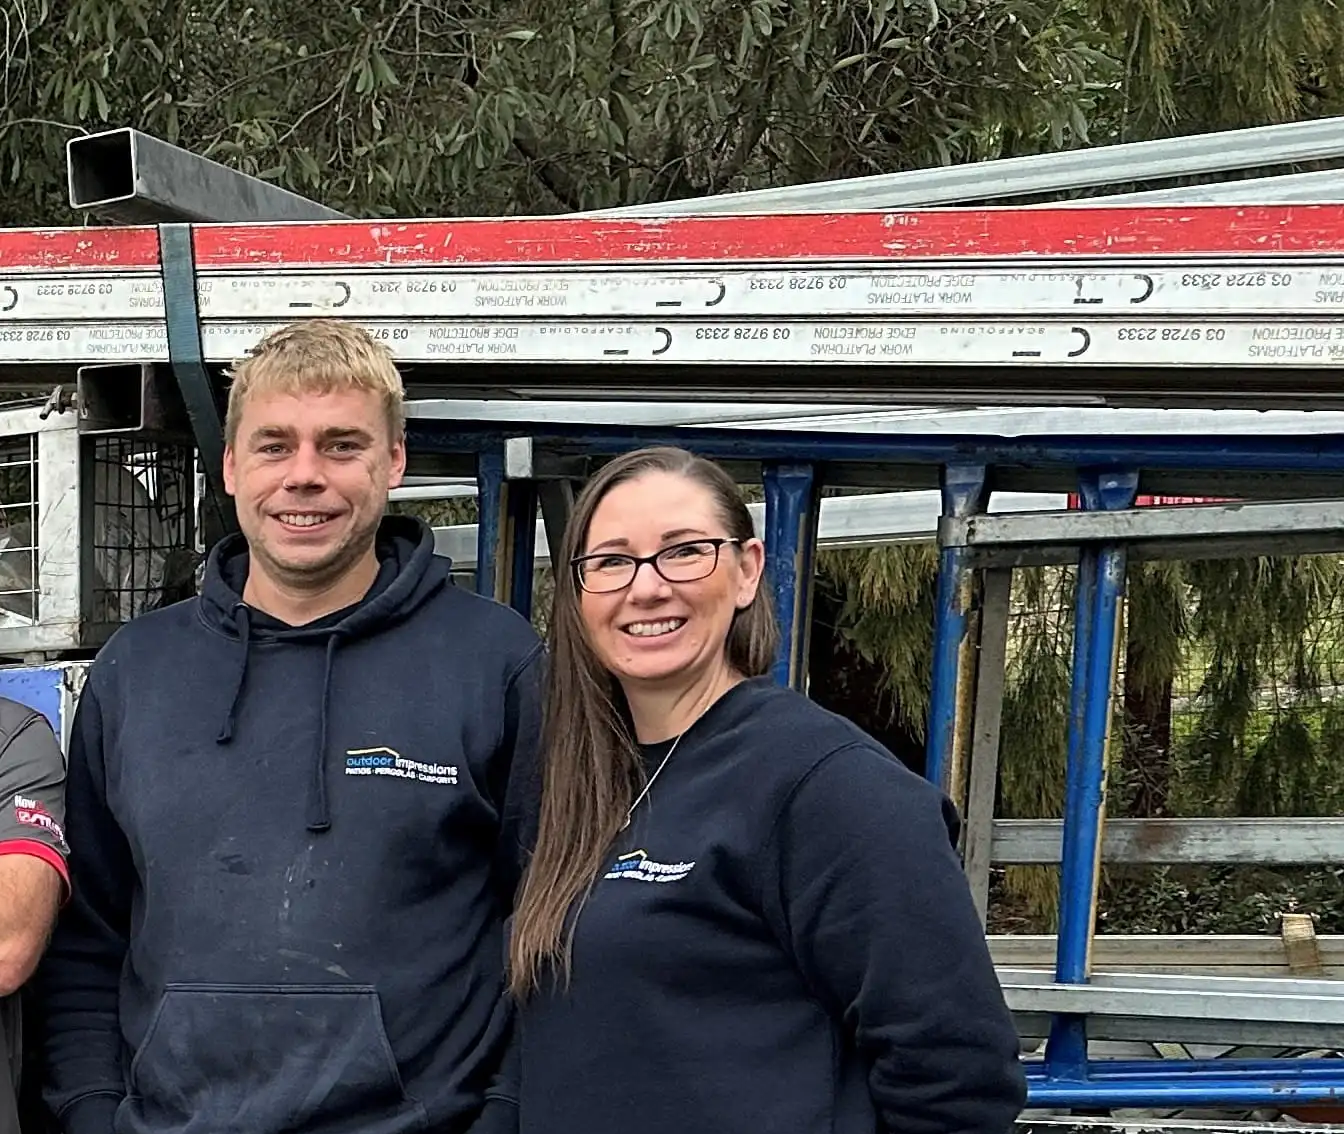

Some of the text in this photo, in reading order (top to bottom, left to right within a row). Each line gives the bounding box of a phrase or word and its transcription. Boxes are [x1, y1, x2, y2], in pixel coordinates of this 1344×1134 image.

[750, 277, 846, 289] 03 9728 2333
[1272, 274, 1292, 286] 03
[98, 284, 112, 295] 03
[441, 281, 456, 292] 03
[537, 296, 567, 306] WORK
[867, 292, 972, 303] WORK PLATFORMS
[26, 330, 52, 340] 9728
[57, 330, 70, 340] 03
[393, 329, 408, 339] 03
[493, 328, 518, 338] EDGE
[696, 328, 790, 339] 03 9728 2333
[888, 328, 916, 338] EDGE
[1118, 328, 1225, 340] 03 9728 2333
[1252, 328, 1332, 340] PROTECTION
[426, 343, 517, 353] WORK PLATFORMS
[811, 344, 912, 354] WORK PLATFORMS
[1248, 345, 1324, 357] PLATFORMS
[346, 756, 458, 776] outdoor impressions
